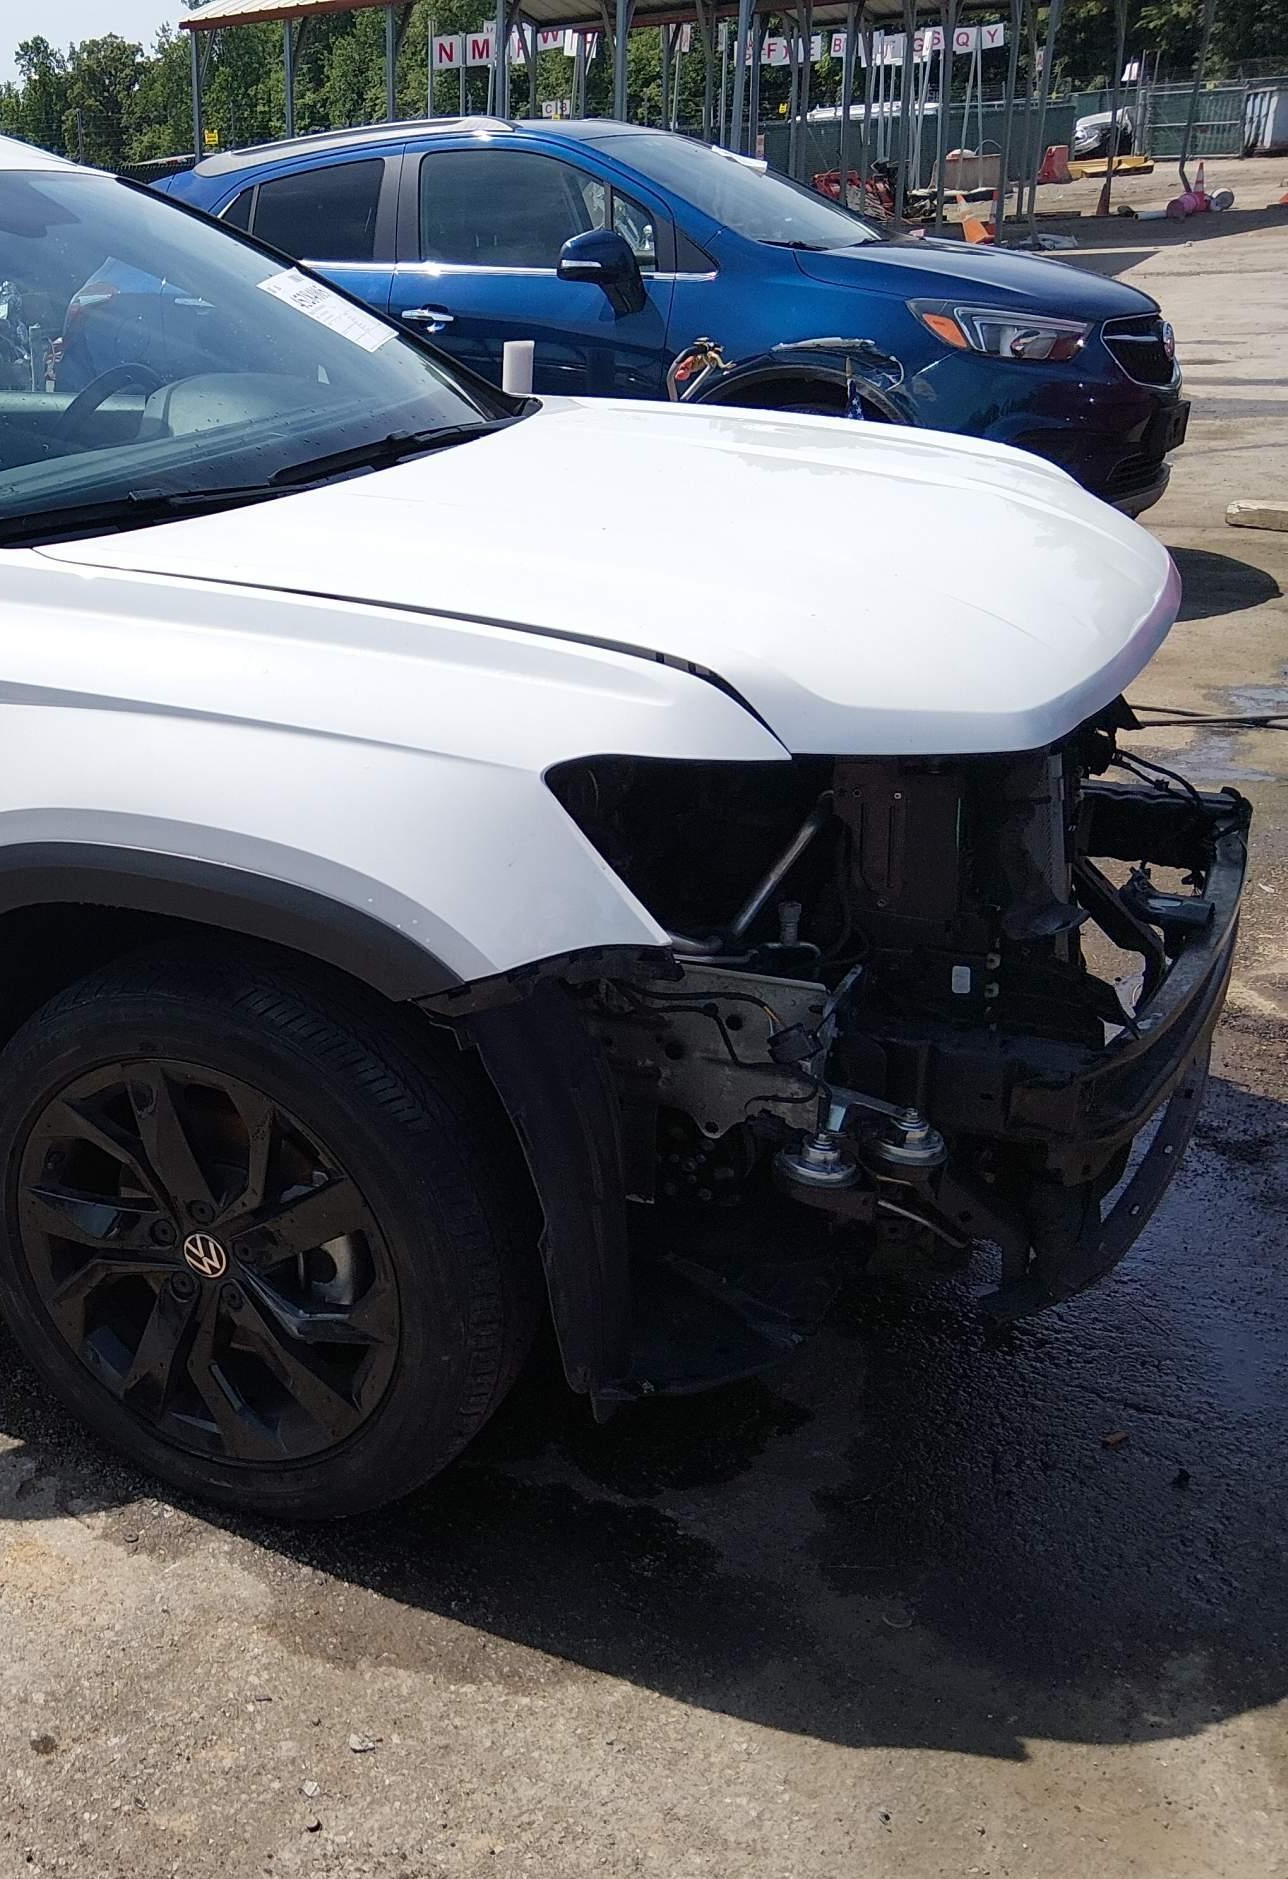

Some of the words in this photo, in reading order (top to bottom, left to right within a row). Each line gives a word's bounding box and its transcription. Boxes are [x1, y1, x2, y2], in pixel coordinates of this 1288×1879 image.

[955, 31, 970, 48] Q
[986, 28, 999, 43] Y
[438, 41, 454, 63] N
[471, 38, 490, 60] M
[767, 42, 778, 59] F
[833, 37, 842, 53] B
[185, 1233, 225, 1277] VW
